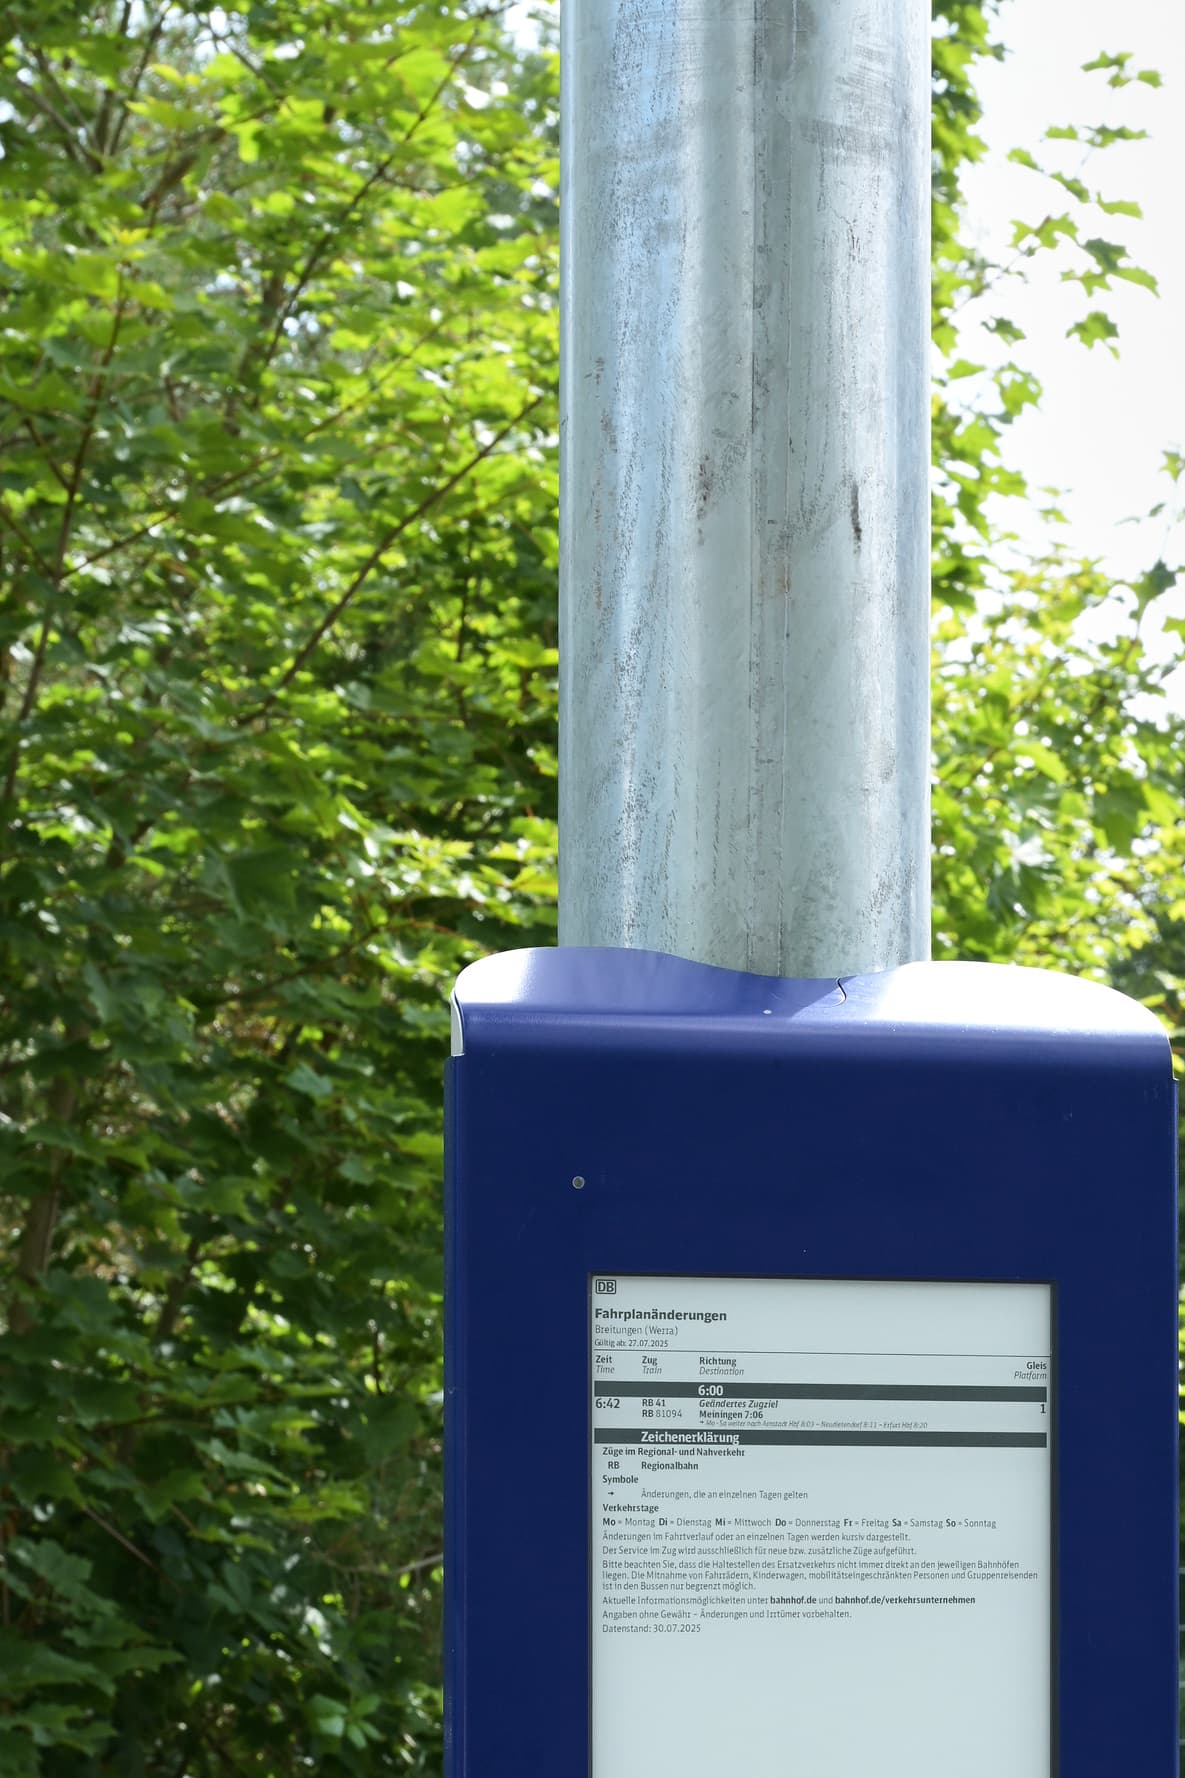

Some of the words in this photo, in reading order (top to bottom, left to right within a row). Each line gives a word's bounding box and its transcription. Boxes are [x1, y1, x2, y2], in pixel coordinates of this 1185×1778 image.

[598, 1282, 614, 1292] DB
[595, 1309, 726, 1323] Fahrplanänderungen
[595, 1326, 642, 1336] Breitungen
[645, 1326, 678, 1336] (Werra)
[595, 1339, 615, 1348] Gültig
[642, 1356, 657, 1366] Zug
[700, 1357, 737, 1366] Richtung
[596, 1366, 615, 1374] Time
[643, 1366, 662, 1374] Train
[700, 1367, 744, 1376] Destination
[1014, 1371, 1047, 1380] Platform
[698, 1385, 723, 1395] 6:00
[596, 1399, 620, 1409] 6:42
[700, 1400, 746, 1408] Geändertes
[748, 1400, 778, 1409] Zugziel
[1040, 1404, 1046, 1413] 1
[700, 1411, 742, 1420] Meiningen
[641, 1432, 740, 1445] Zeichenerklärung
[603, 1448, 623, 1457] Züge
[626, 1448, 636, 1457] im
[638, 1448, 677, 1457] Regional-
[679, 1448, 694, 1457] und
[697, 1448, 745, 1457] Nahverkehr
[642, 1462, 698, 1471] Regionalbahn
[603, 1475, 638, 1484] Symbole
[642, 1490, 692, 1499] Änderungen,
[694, 1490, 705, 1499] die
[708, 1490, 717, 1499] an
[719, 1490, 757, 1499] einzelnen
[760, 1490, 782, 1499] Tagen
[784, 1490, 808, 1499] gelten
[603, 1504, 659, 1513] Verkehrstage
[603, 1518, 615, 1527] Mo
[625, 1518, 655, 1527] Montag
[659, 1518, 668, 1527] Di
[677, 1518, 711, 1527] Dienstag
[716, 1518, 725, 1527] Mi
[735, 1518, 771, 1527] Mittwoch
[776, 1518, 786, 1527] Do
[796, 1518, 840, 1527] Donnerstag
[844, 1519, 852, 1528] Fr
[862, 1519, 889, 1528] Freitag
[892, 1519, 901, 1528] Sa
[910, 1519, 943, 1528] Samstag
[946, 1519, 956, 1528] So
[964, 1519, 996, 1528] Sonntag
[603, 1533, 651, 1542] Änderungen
[653, 1533, 663, 1542] im
[665, 1533, 714, 1542] Fahrtverlauf
[716, 1533, 734, 1542] oder
[736, 1533, 745, 1542] an
[747, 1533, 785, 1542] einzelnen
[788, 1533, 809, 1542] Tagen
[811, 1534, 839, 1542] werden
[842, 1534, 864, 1542] kursiv
[867, 1534, 910, 1542] dargestellt.
[603, 1547, 617, 1556] Der
[619, 1547, 648, 1556] Service
[650, 1547, 660, 1556] im
[662, 1547, 676, 1556] Zug
[678, 1547, 696, 1556] wird
[755, 1547, 766, 1556] für
[768, 1547, 787, 1556] neue
[789, 1547, 806, 1556] bzw.
[808, 1547, 851, 1556] zusätzliche
[853, 1547, 872, 1556] Züge
[874, 1547, 917, 1556] aufgeführt.
[603, 1560, 622, 1570] Bitte
[624, 1560, 661, 1570] beachten
[663, 1560, 676, 1570] Sie,
[679, 1560, 696, 1570] dass
[699, 1560, 710, 1570] die
[713, 1560, 760, 1570] Haltestellen
[762, 1560, 775, 1570] des
[778, 1560, 835, 1569] Ersatzverkehrs
[838, 1560, 856, 1570] nicht
[859, 1560, 883, 1570] immer
[886, 1560, 908, 1570] direkt
[910, 1560, 919, 1570] an
[921, 1560, 935, 1570] den
[937, 1560, 976, 1570] jeweiligen
[978, 1560, 1019, 1570] Bahnhöfen
[603, 1571, 628, 1581] liegen.
[632, 1571, 644, 1581] Die
[647, 1571, 687, 1581] Mitnahme
[689, 1571, 703, 1581] von
[705, 1571, 750, 1581] Fahrrädern,
[753, 1571, 806, 1581] Kinderwagen,
[809, 1571, 911, 1581] mobilitätseingeschränkten
[914, 1571, 949, 1581] Personen
[951, 1571, 965, 1581] und
[968, 1571, 1037, 1581] Gruppenreisenden
[603, 1582, 613, 1591] ist
[615, 1582, 622, 1591] in
[624, 1582, 638, 1591] den
[641, 1582, 668, 1591] Bussen
[671, 1582, 684, 1591] nur
[686, 1582, 720, 1591] begrenzt
[723, 1582, 756, 1591] möglich.
[603, 1597, 636, 1606] Aktuelle
[638, 1597, 745, 1606] Informationsmöglichkeiten
[748, 1597, 768, 1606] unter
[771, 1597, 816, 1606] bahnhof.de
[819, 1596, 833, 1605] und
[835, 1596, 975, 1605] bahnhof.de/verkehrsunternehmen
[603, 1611, 637, 1620] Angaben
[639, 1611, 658, 1620] ohne
[661, 1611, 690, 1620] Gewähr
[700, 1611, 748, 1620] Änderungen
[750, 1611, 764, 1620] und
[767, 1611, 800, 1620] Irrtümer
[603, 1624, 651, 1633] Datenstand:
[653, 1624, 701, 1633] 30.07.2025
